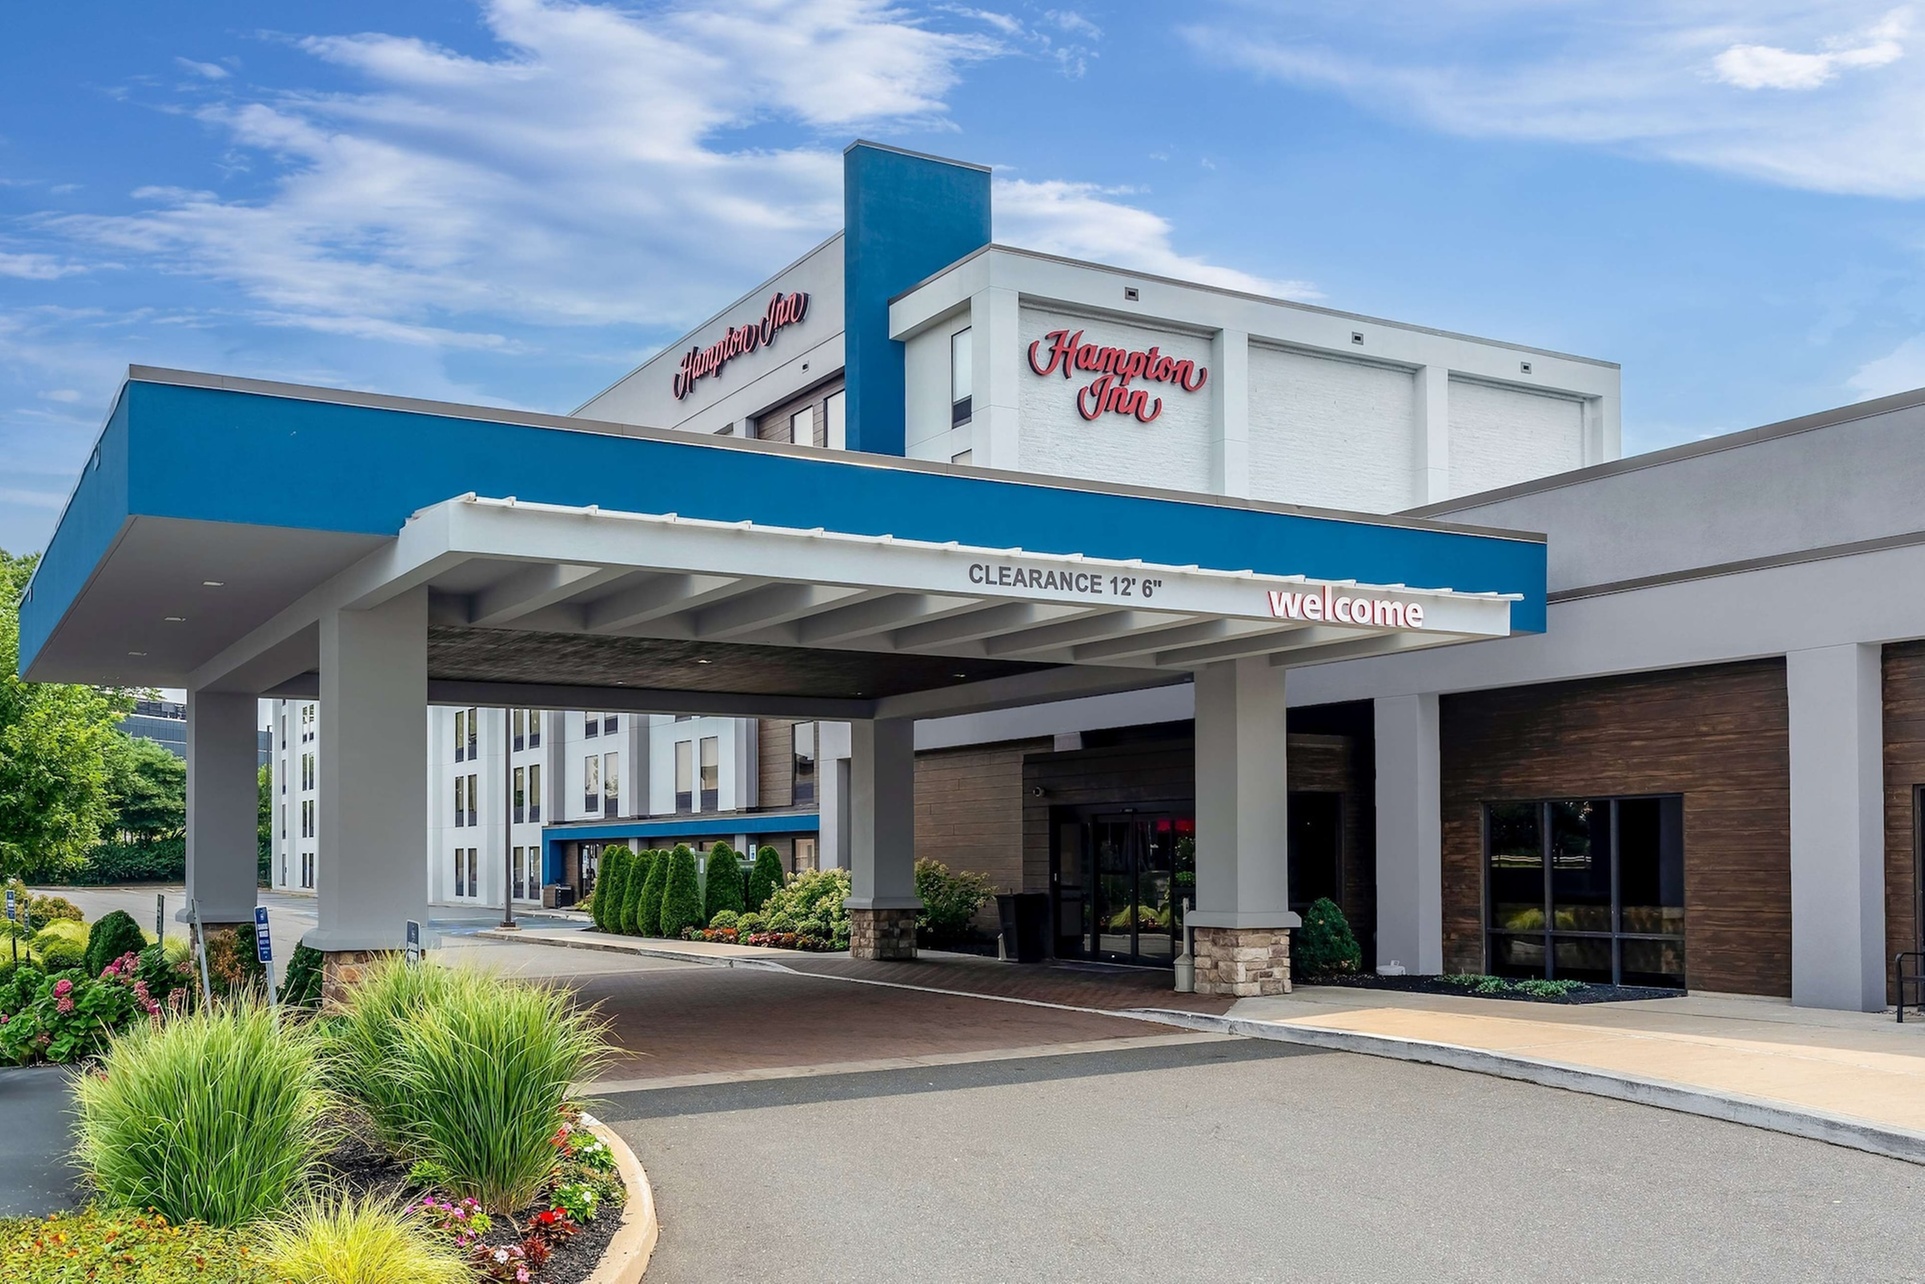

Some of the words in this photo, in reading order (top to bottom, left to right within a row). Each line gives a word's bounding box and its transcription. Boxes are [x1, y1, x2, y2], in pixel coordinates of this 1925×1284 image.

[673, 325, 759, 400] Hampton
[759, 292, 811, 347] Inn
[1028, 329, 1208, 392] Hampton
[1077, 374, 1162, 423] Inn
[968, 563, 1103, 594] CLEARANCE
[1109, 576, 1136, 597] 12'
[1141, 579, 1163, 599] 6"
[1267, 585, 1425, 629] welcome
